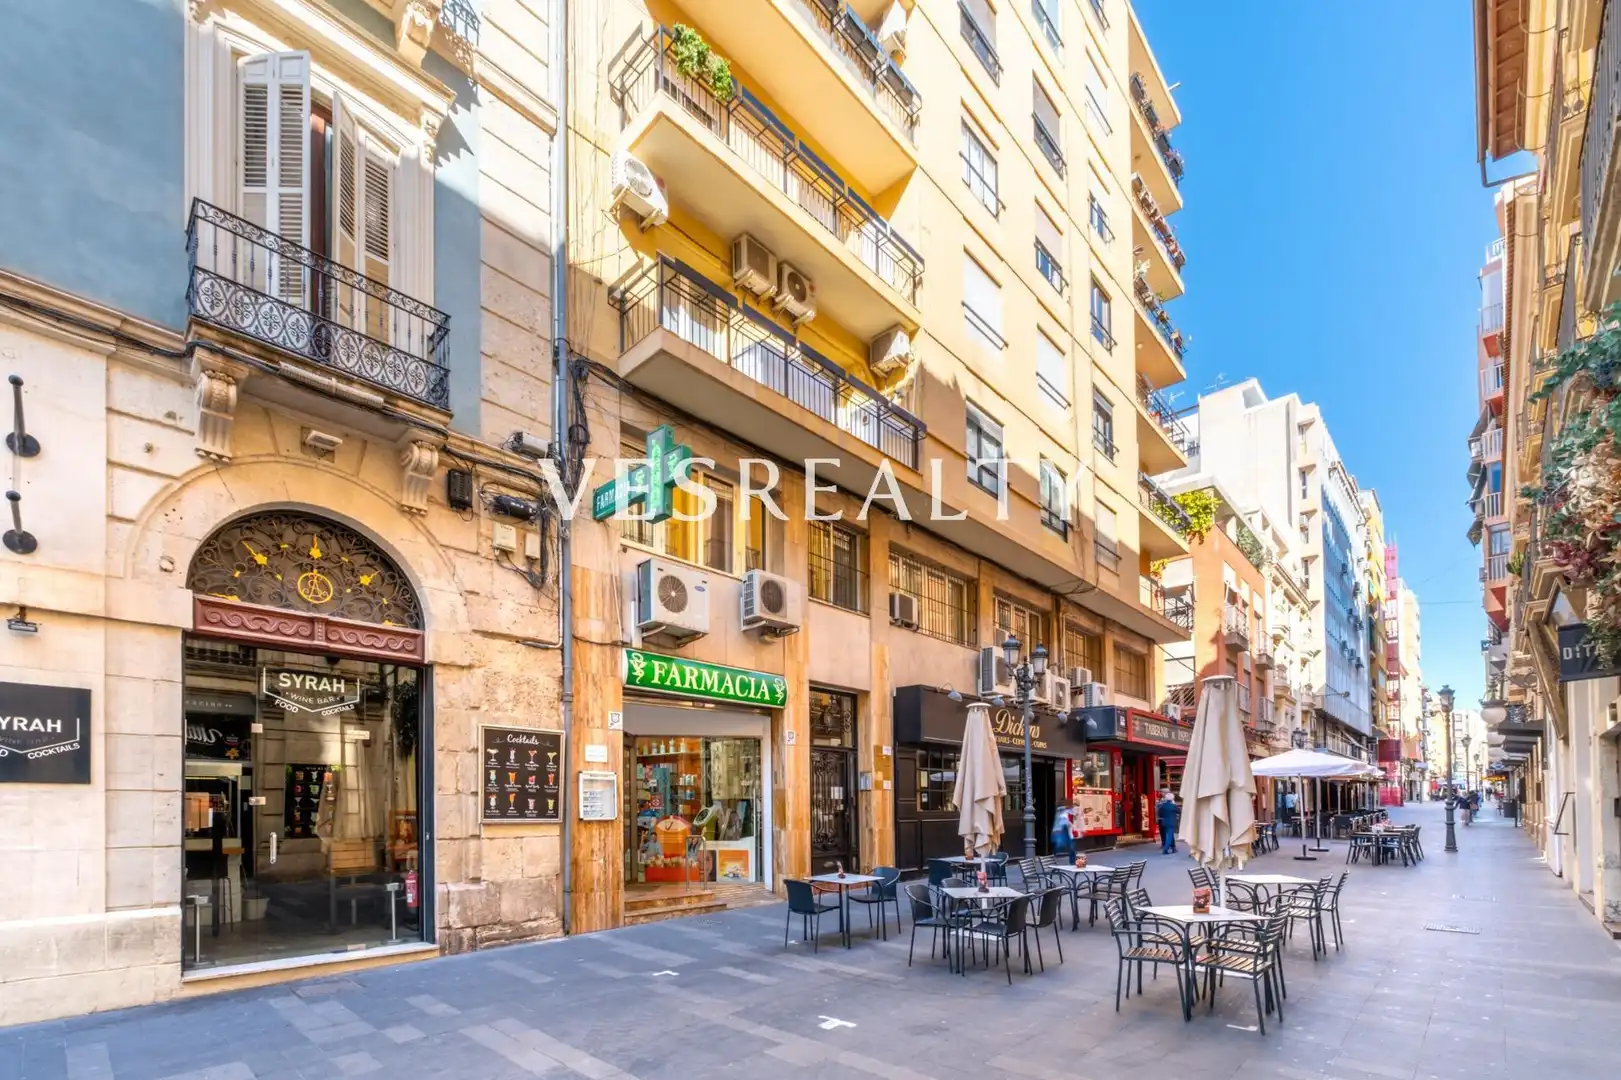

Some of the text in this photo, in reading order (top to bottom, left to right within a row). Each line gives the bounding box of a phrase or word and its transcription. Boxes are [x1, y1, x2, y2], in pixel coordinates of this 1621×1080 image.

[278, 672, 345, 693] SYRAH
[651, 659, 771, 701] FARMACIA
[274, 699, 299, 713] FOOD
[290, 691, 336, 705] WINE BAR
[321, 704, 355, 716] COCKTAILS
[0, 716, 62, 733] YRAH
[992, 708, 1040, 739] Dickns
[506, 733, 540, 746] Cocktails
[27, 742, 80, 760] COCKTAILS
